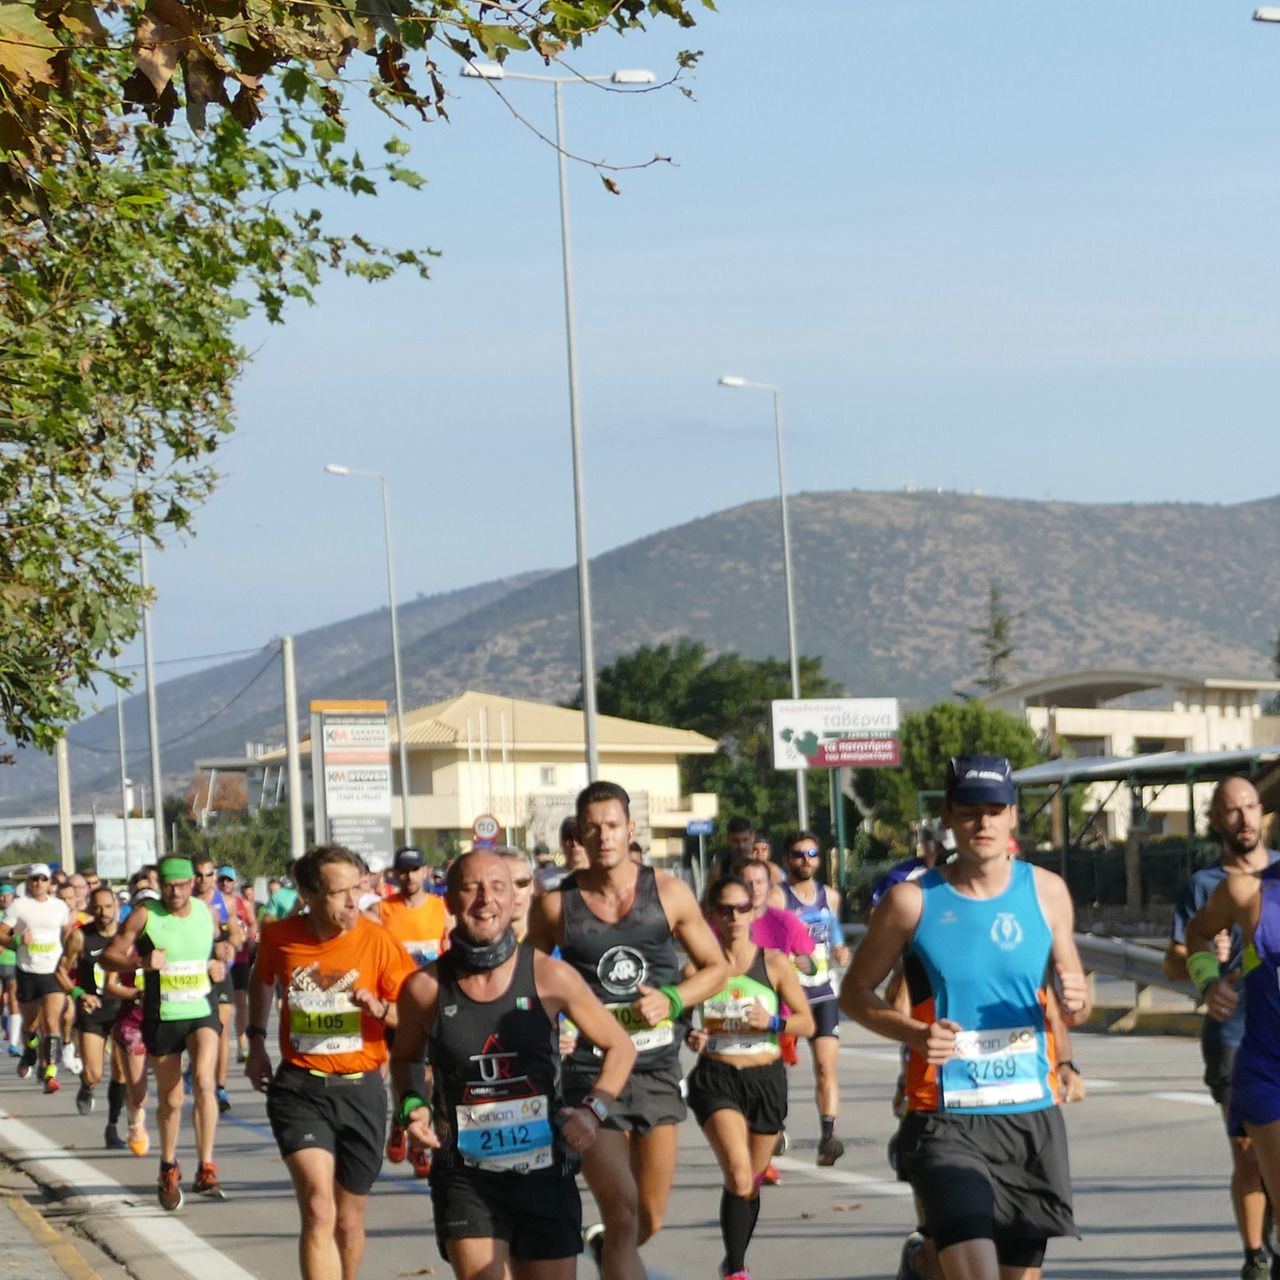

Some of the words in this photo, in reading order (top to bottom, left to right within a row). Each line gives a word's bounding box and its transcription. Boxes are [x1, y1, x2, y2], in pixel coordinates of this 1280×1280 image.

[304, 1013, 344, 1029] 1105
[966, 1056, 1018, 1081] 3769
[480, 1123, 533, 1152] 2112
